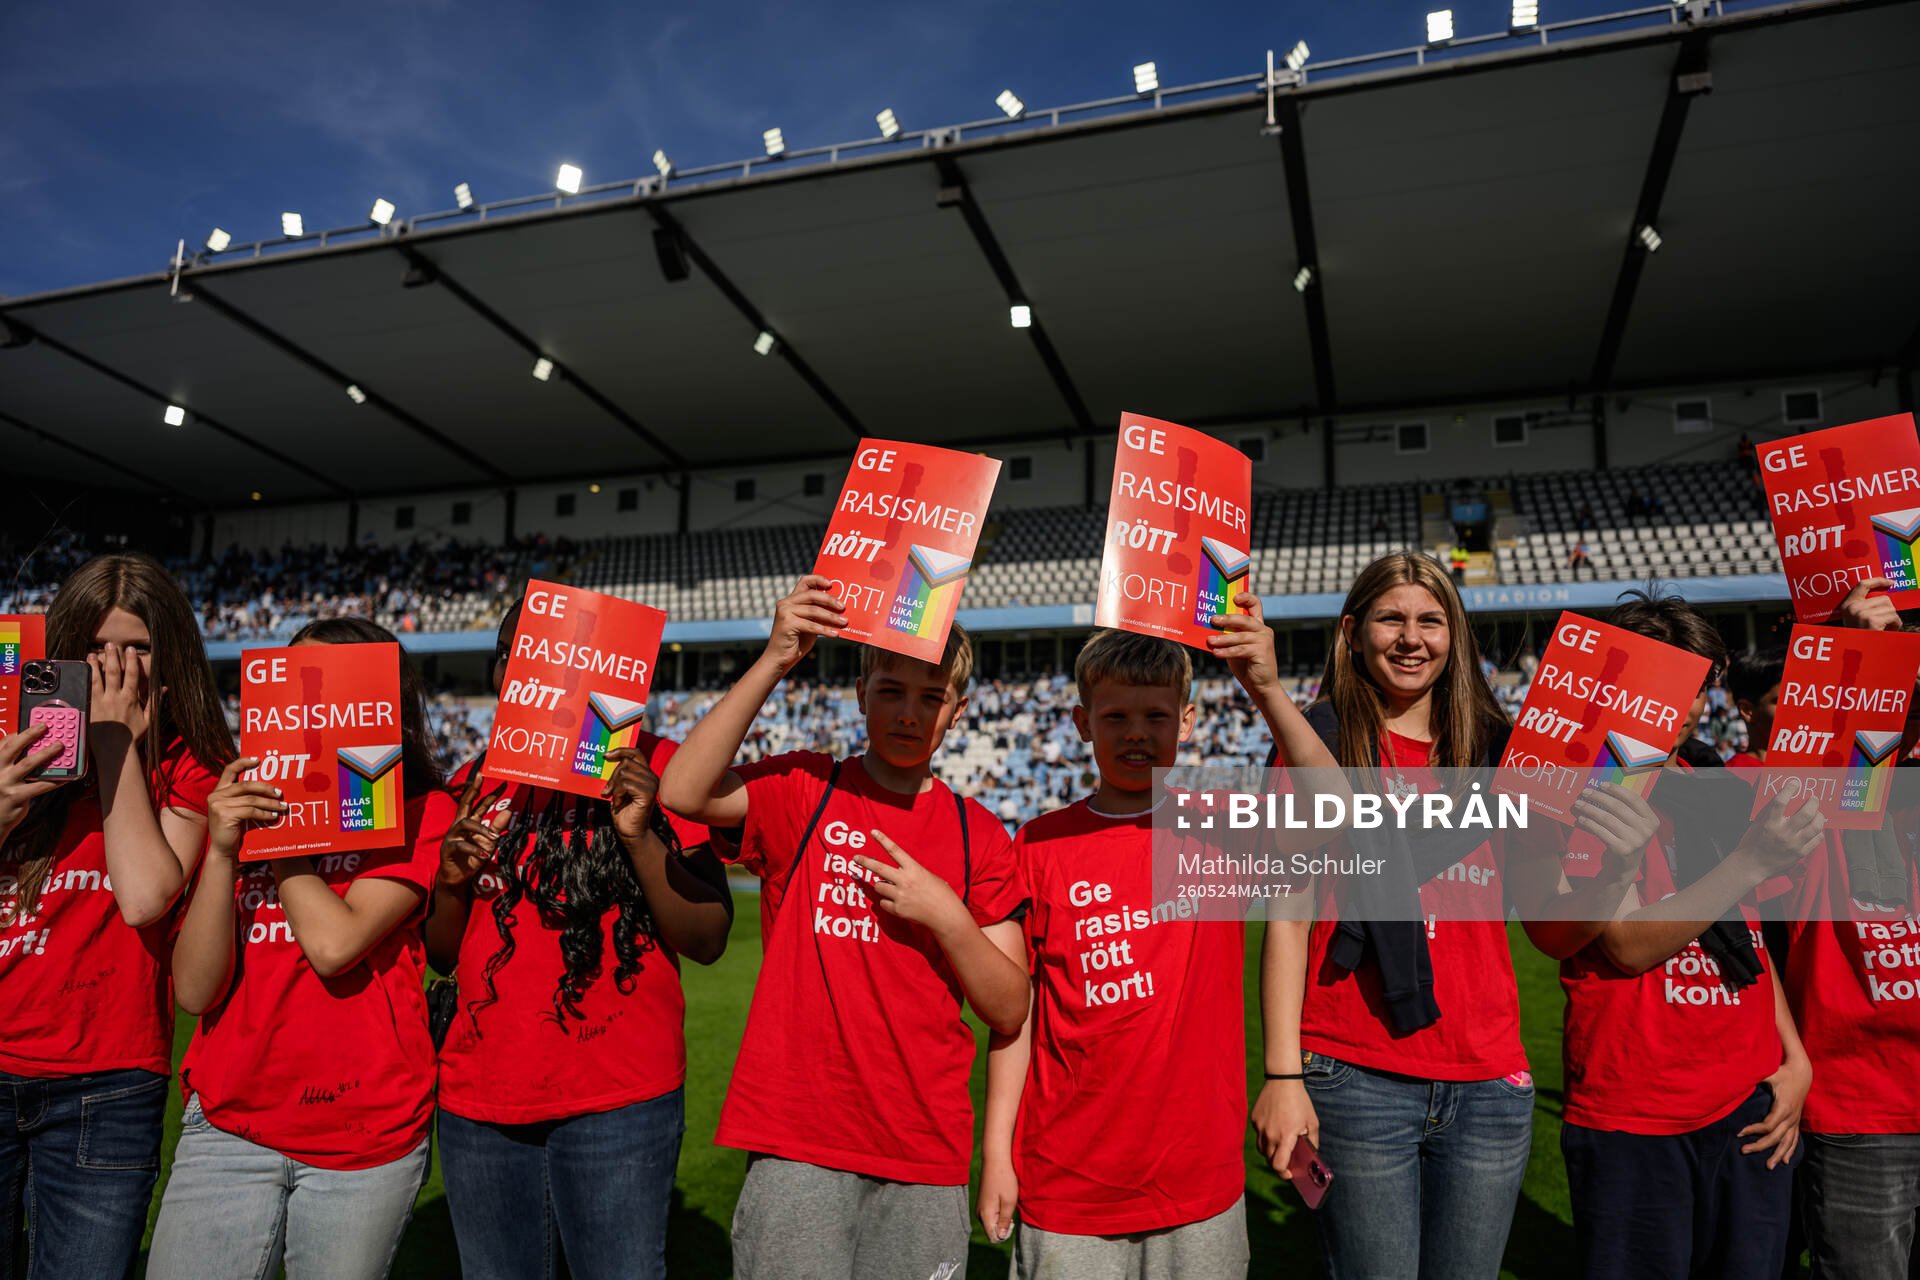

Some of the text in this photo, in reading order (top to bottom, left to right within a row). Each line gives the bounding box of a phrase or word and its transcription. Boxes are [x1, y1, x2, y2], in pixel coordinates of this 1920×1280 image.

[1124, 425, 1166, 455] GE
[857, 448, 897, 473] GE
[1764, 444, 1808, 472] GE
[1118, 471, 1246, 534] RASISMER
[1773, 467, 1920, 516] RASISMER
[840, 490, 976, 537] RASISMER
[823, 529, 887, 563] RÖTT
[1110, 518, 1178, 555] RÖTT
[1784, 524, 1846, 558] RÖTT
[1883, 558, 1912, 569] ALLAS
[1885, 569, 1906, 579] LIKA
[528, 591, 568, 618] GE
[895, 594, 925, 609] ALLAS
[1105, 570, 1188, 612] KORT!
[1199, 590, 1225, 604] ALLAS
[1474, 588, 1570, 605] STADION
[892, 605, 913, 618] LIKA
[1197, 601, 1217, 614] LIKA
[888, 615, 919, 632] VÄRDE
[1558, 624, 1600, 654] GE
[1793, 635, 1834, 661] GE
[4, 643, 15, 674] VÄRDE
[246, 657, 287, 684] GE
[516, 634, 648, 685] RASISMER
[503, 677, 566, 711] RÖTT
[1538, 664, 1678, 732] RASISMER
[1783, 682, 1907, 713] RASISMER
[246, 701, 394, 733] RASISMER
[1519, 707, 1583, 743] RÖTT
[493, 725, 569, 761] KORT!
[579, 741, 606, 753] ALLAS
[1772, 724, 1834, 755] RÖTT
[574, 762, 602, 775] VÄRDE
[576, 751, 596, 762] LIKA
[1504, 748, 1578, 794] KORT!
[1845, 779, 1869, 787] ALLAS
[341, 797, 371, 807] ALLAS
[1841, 799, 1865, 808] VÄRDE
[1843, 789, 1860, 797] LIKA
[342, 809, 363, 818] LIKA
[342, 818, 374, 828] VÄRDE
[824, 821, 866, 848] Ge
[818, 879, 866, 908] rött
[1069, 880, 1112, 908] Ge
[814, 907, 880, 943] kort!
[1075, 894, 1200, 941] rasismer
[1080, 938, 1134, 974] rött
[1085, 970, 1154, 1008] kort!
[1664, 979, 1741, 1006] kort!
